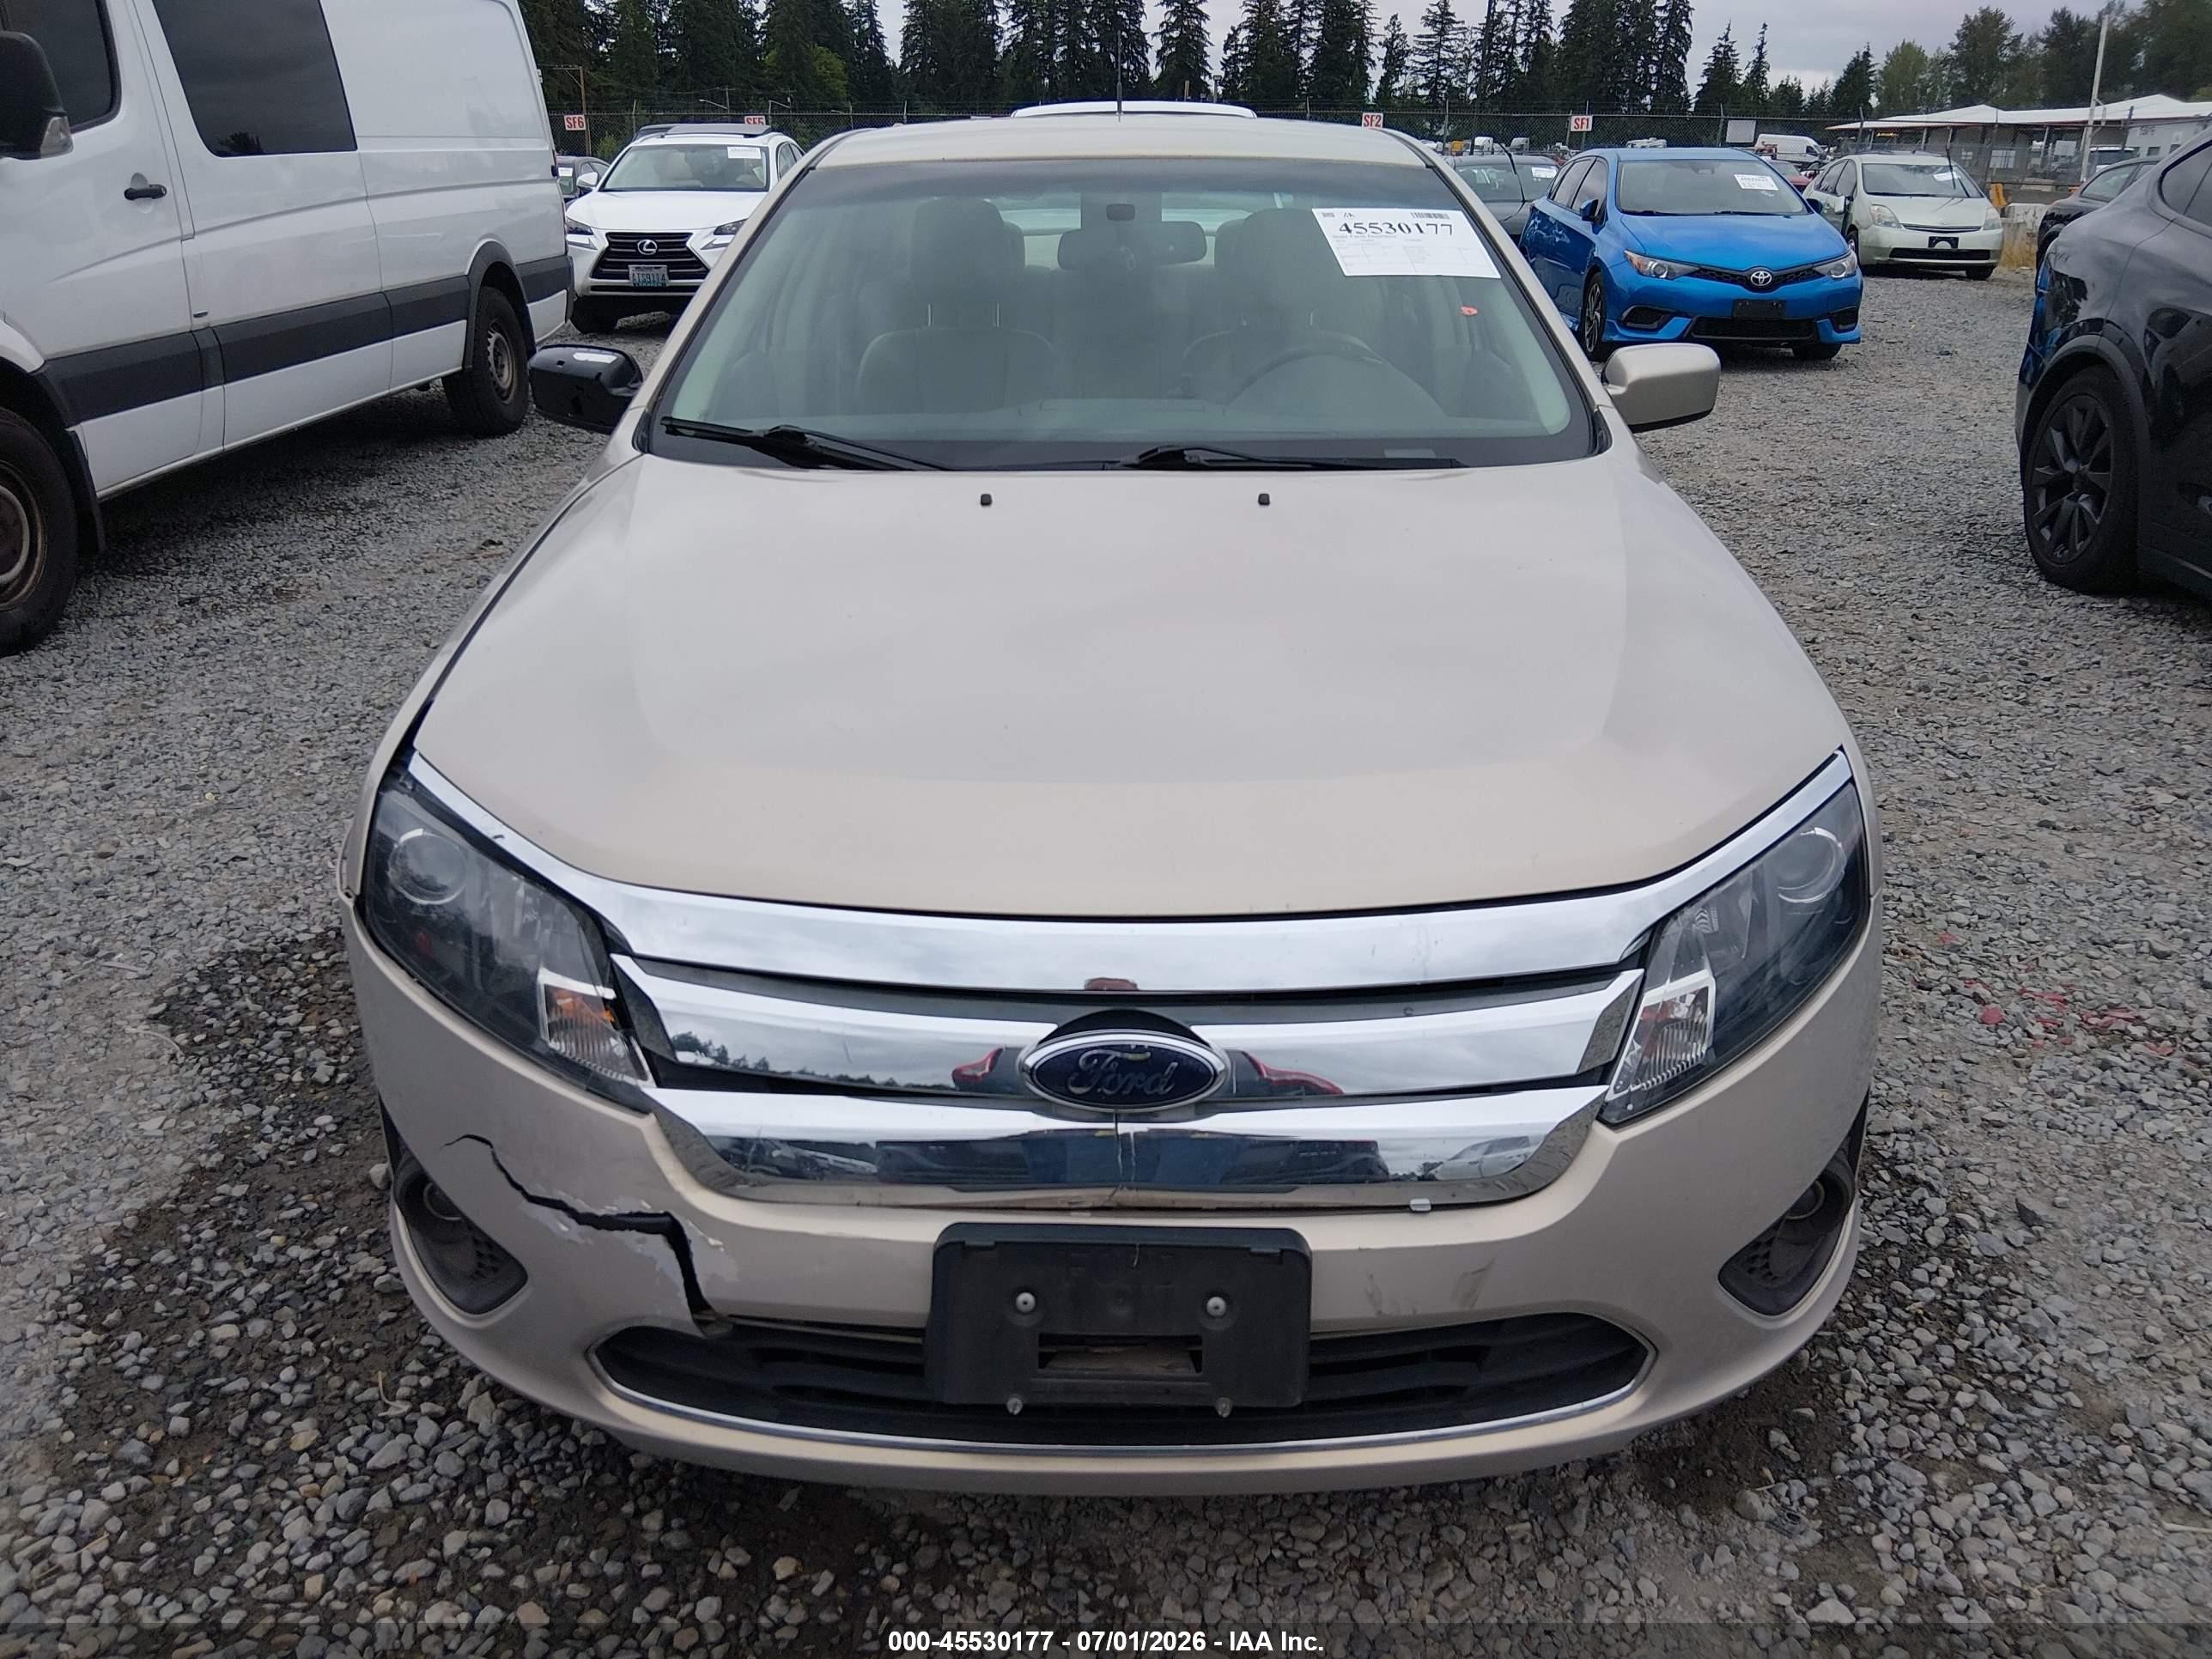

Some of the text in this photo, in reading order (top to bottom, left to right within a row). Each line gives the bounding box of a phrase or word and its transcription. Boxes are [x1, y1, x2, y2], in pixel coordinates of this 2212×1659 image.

[566, 116, 585, 129] SF6
[1364, 114, 1382, 127] SF2
[1573, 117, 1589, 130] SF1
[1339, 222, 1453, 236] 45530177
[1067, 1048, 1178, 1096] Ford
